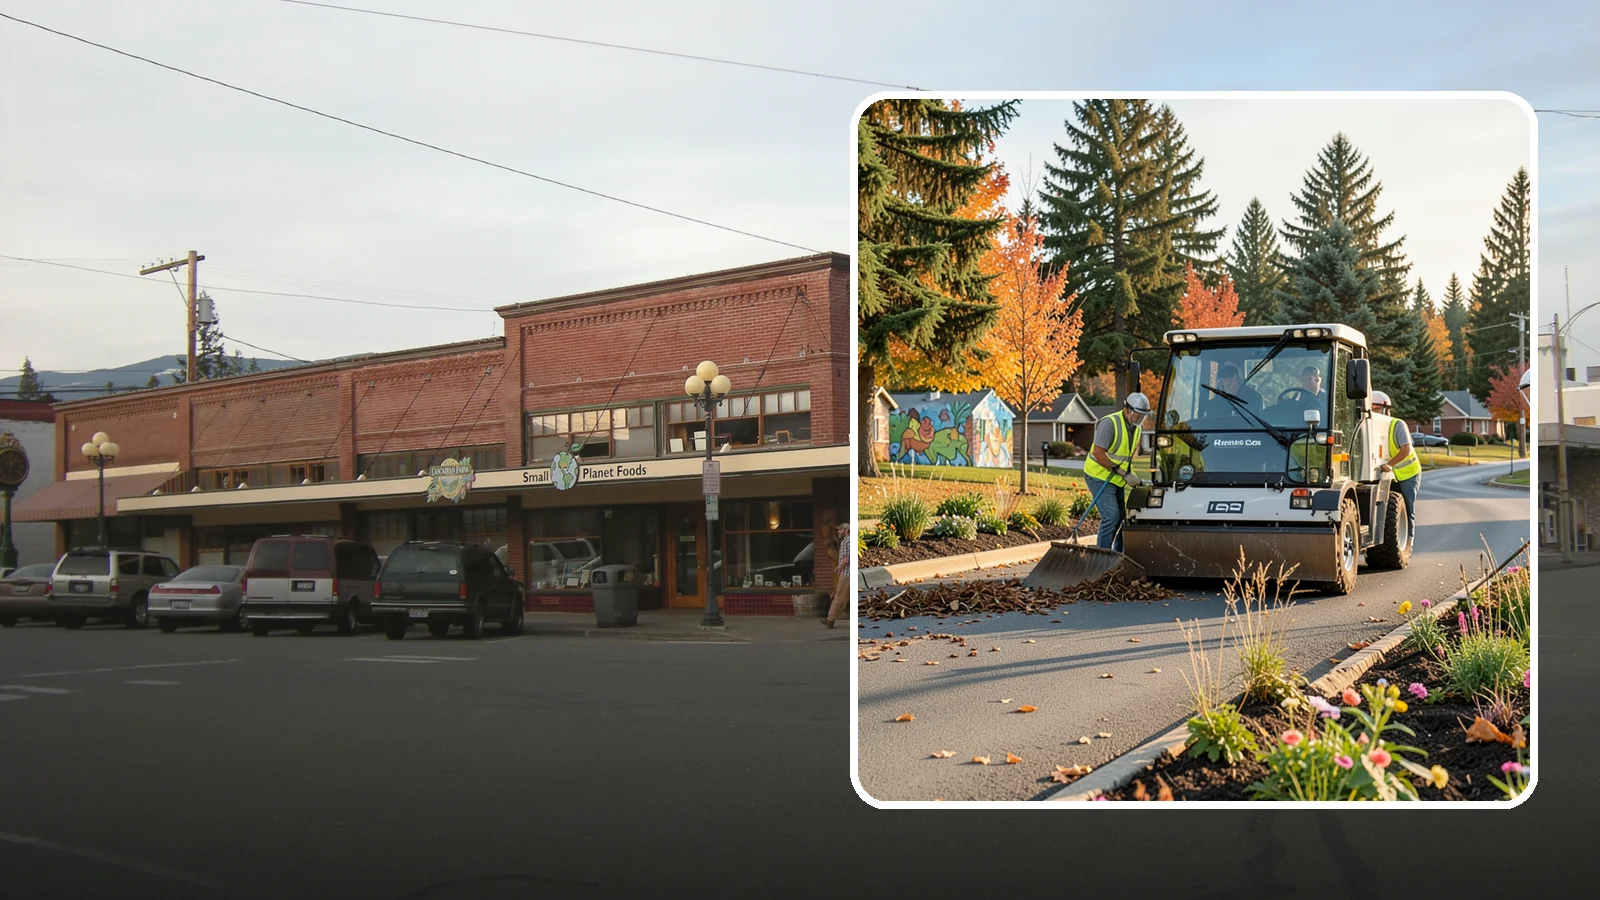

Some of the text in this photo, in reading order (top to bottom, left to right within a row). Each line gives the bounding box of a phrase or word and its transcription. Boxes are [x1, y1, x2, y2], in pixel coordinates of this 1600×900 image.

[523, 464, 647, 483] Small Planet Foods
